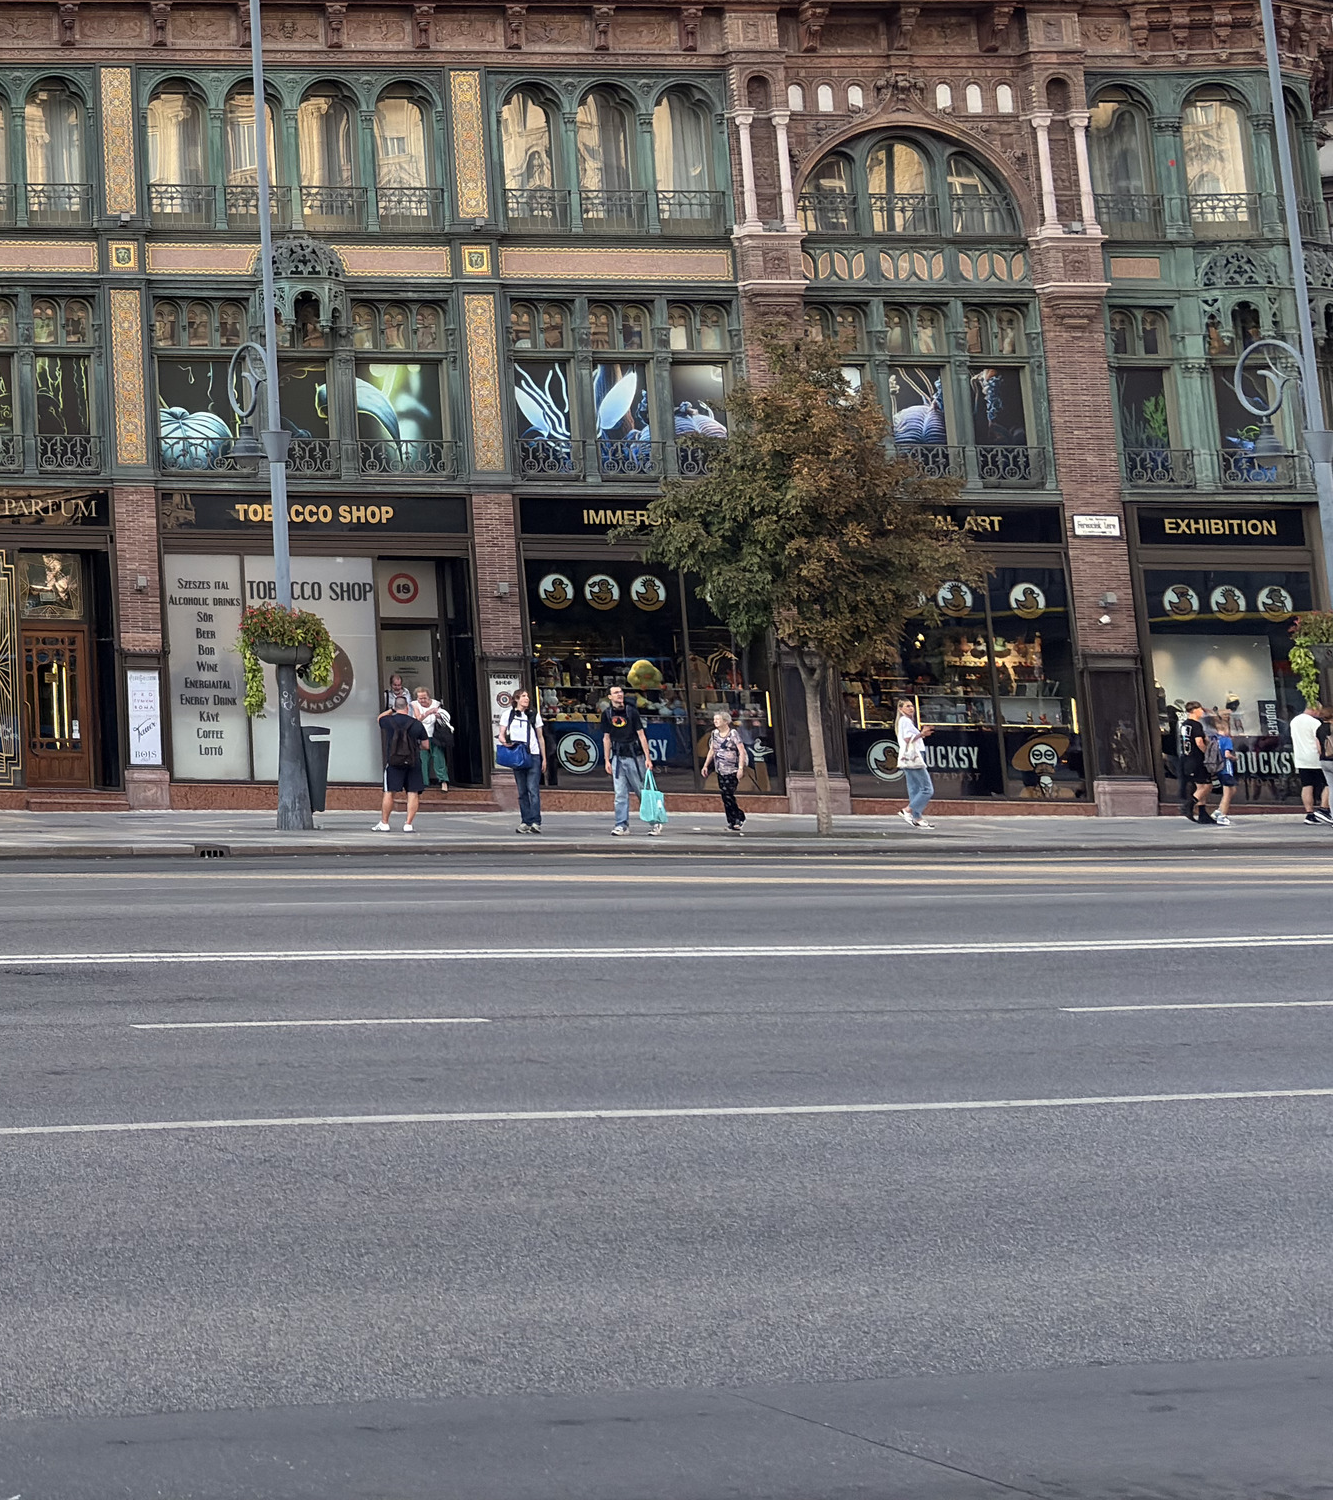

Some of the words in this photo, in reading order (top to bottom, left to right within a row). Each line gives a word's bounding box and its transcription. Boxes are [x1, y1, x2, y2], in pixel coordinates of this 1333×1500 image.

[3, 498, 97, 517] PARFUM
[235, 503, 333, 523] TOBCCO
[338, 504, 394, 524] SHOP
[1163, 518, 1277, 535] EXHIBITION
[247, 580, 322, 601] TOBCCO
[329, 581, 373, 602] SHOP
[396, 583, 411, 594] 18
[299, 682, 350, 710] ÁNYBOLT
[135, 750, 157, 759] BOIS
[925, 745, 979, 769] UCKSY
[932, 771, 981, 782] DAPEST
